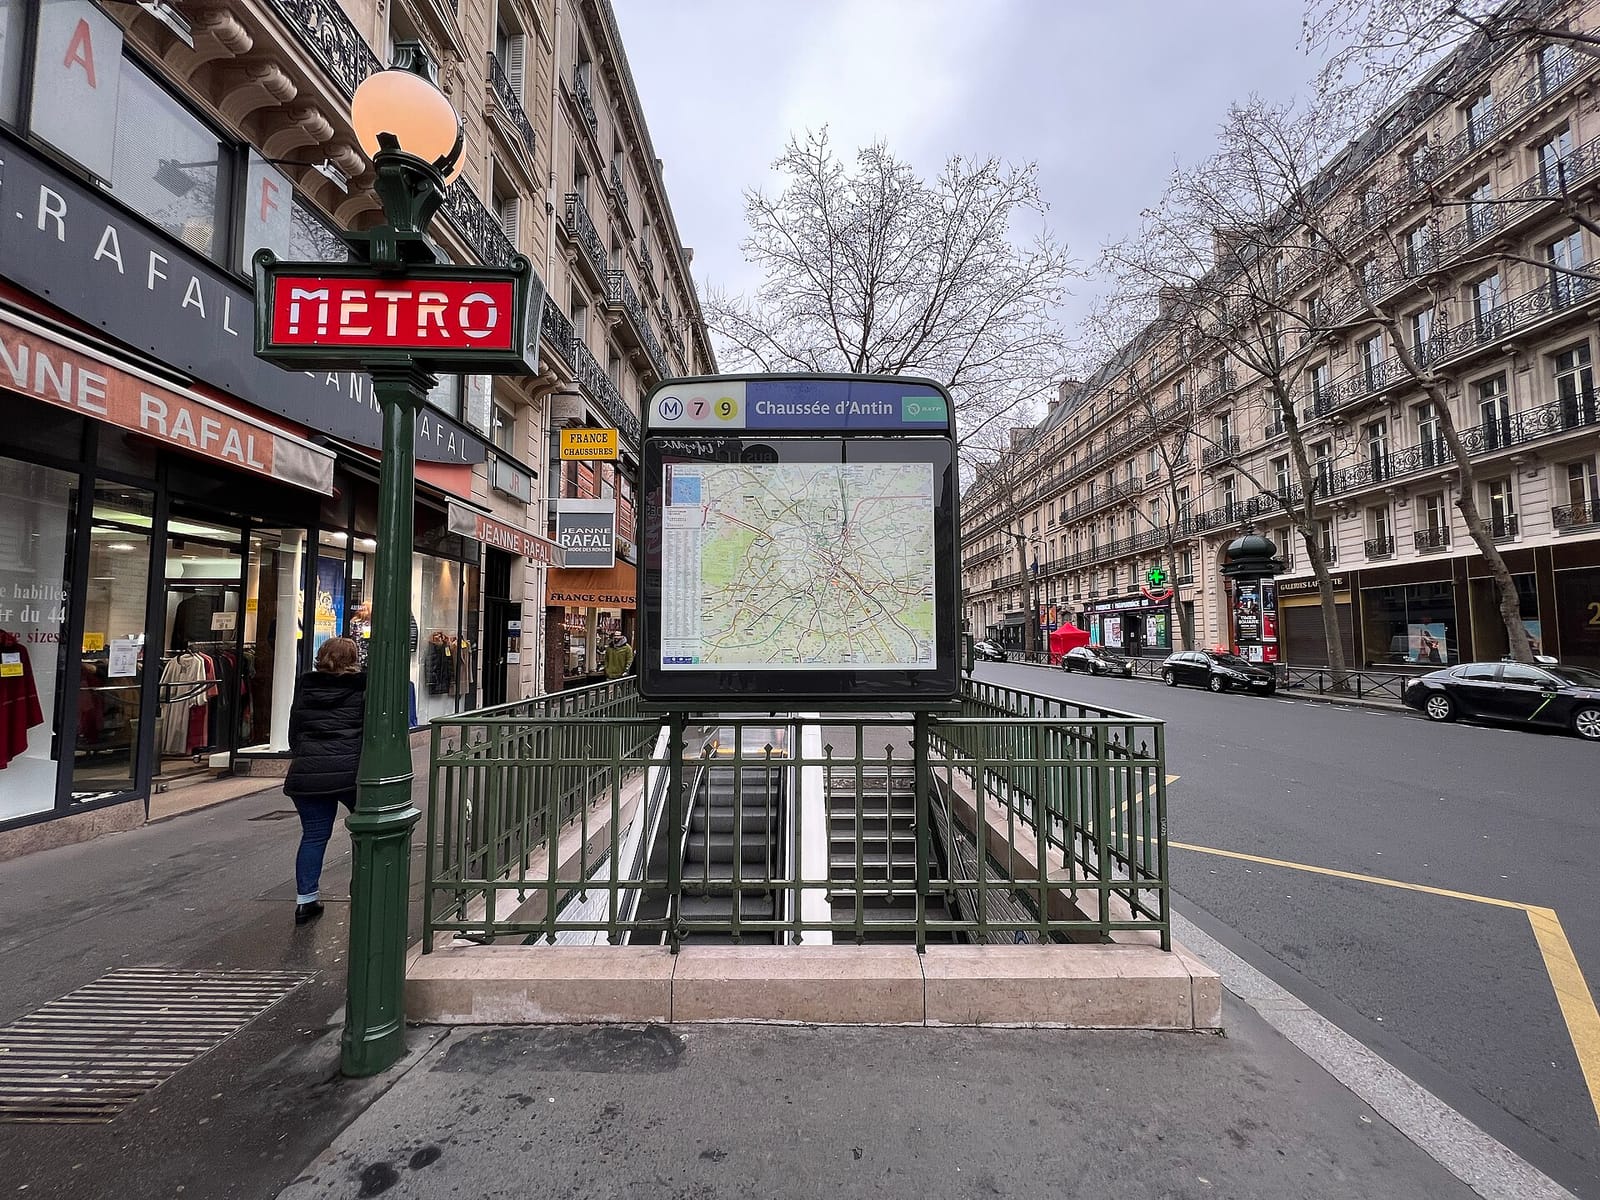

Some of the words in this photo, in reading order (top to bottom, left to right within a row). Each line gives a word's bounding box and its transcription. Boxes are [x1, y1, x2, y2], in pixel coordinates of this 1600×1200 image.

[64, 17, 97, 89] A
[260, 176, 279, 223] F
[288, 287, 498, 339] METRO
[694, 402, 704, 415] 7
[721, 402, 732, 416] 9
[755, 400, 830, 416] Chaussée
[835, 400, 893, 416] d'Antin
[139, 392, 265, 470] RAFAL
[570, 433, 608, 443] FRANCE
[563, 448, 613, 456] CHAUSSURES
[479, 522, 519, 551] JEANNE
[523, 538, 550, 563] RAFAL
[561, 534, 611, 547] RAFAL
[13, 583, 67, 601] habillée
[1280, 582, 1307, 590] GALERIES
[550, 593, 596, 602] FRANCE
[598, 595, 637, 603] CHAUS
[20, 604, 40, 623] du
[47, 606, 66, 624] 44
